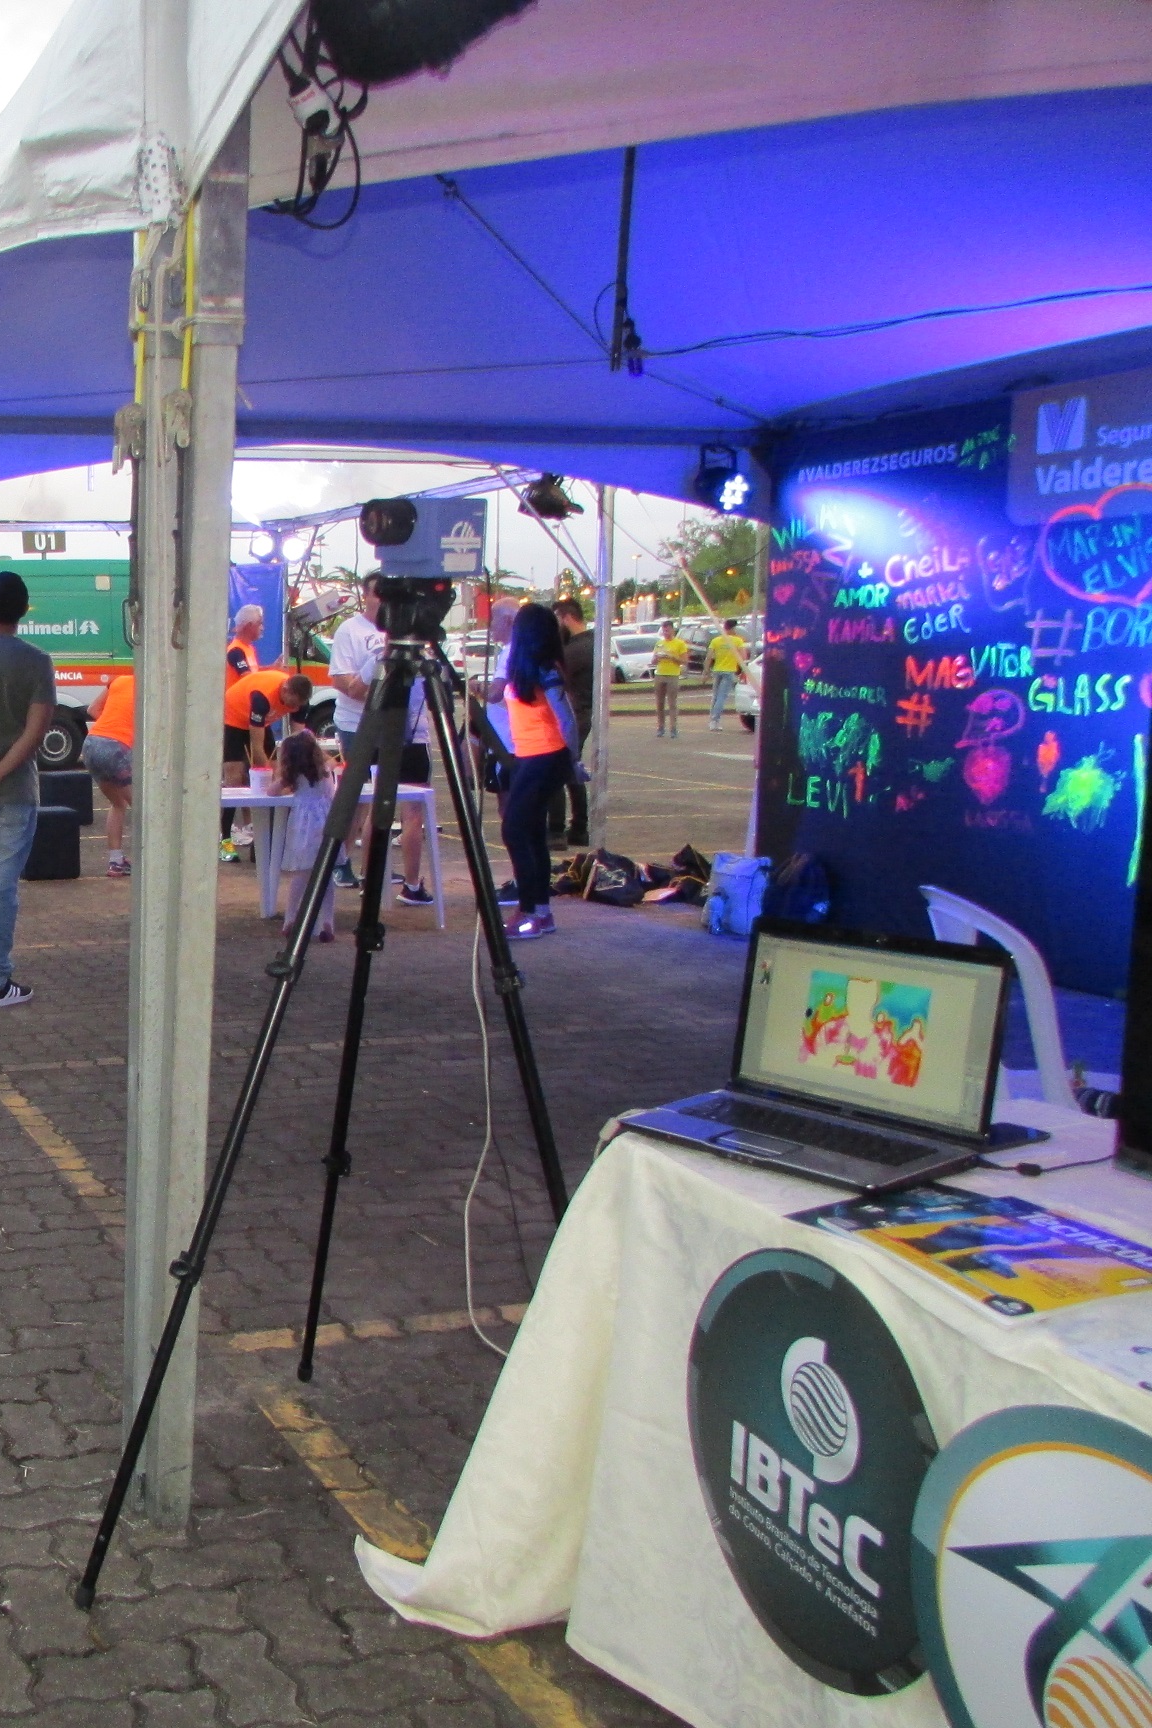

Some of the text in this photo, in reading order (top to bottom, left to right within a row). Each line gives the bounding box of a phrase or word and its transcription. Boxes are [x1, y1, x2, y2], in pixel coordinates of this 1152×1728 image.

[799, 443, 957, 483] #VALDEREZSEGUROS
[33, 531, 56, 551] 01
[833, 582, 890, 609] AMOR
[17, 619, 75, 635] nimed
[970, 642, 1035, 681] VITOR
[1028, 673, 1133, 717] GLASS
[729, 1419, 885, 1600] IBTeC
[728, 1485, 879, 1620] Instituto Brasileiro de Tecnologia
[728, 1503, 741, 1520] do
[774, 1542, 813, 1583] Calçado
[815, 1579, 823, 1592] e
[825, 1587, 878, 1638] Artefatos
